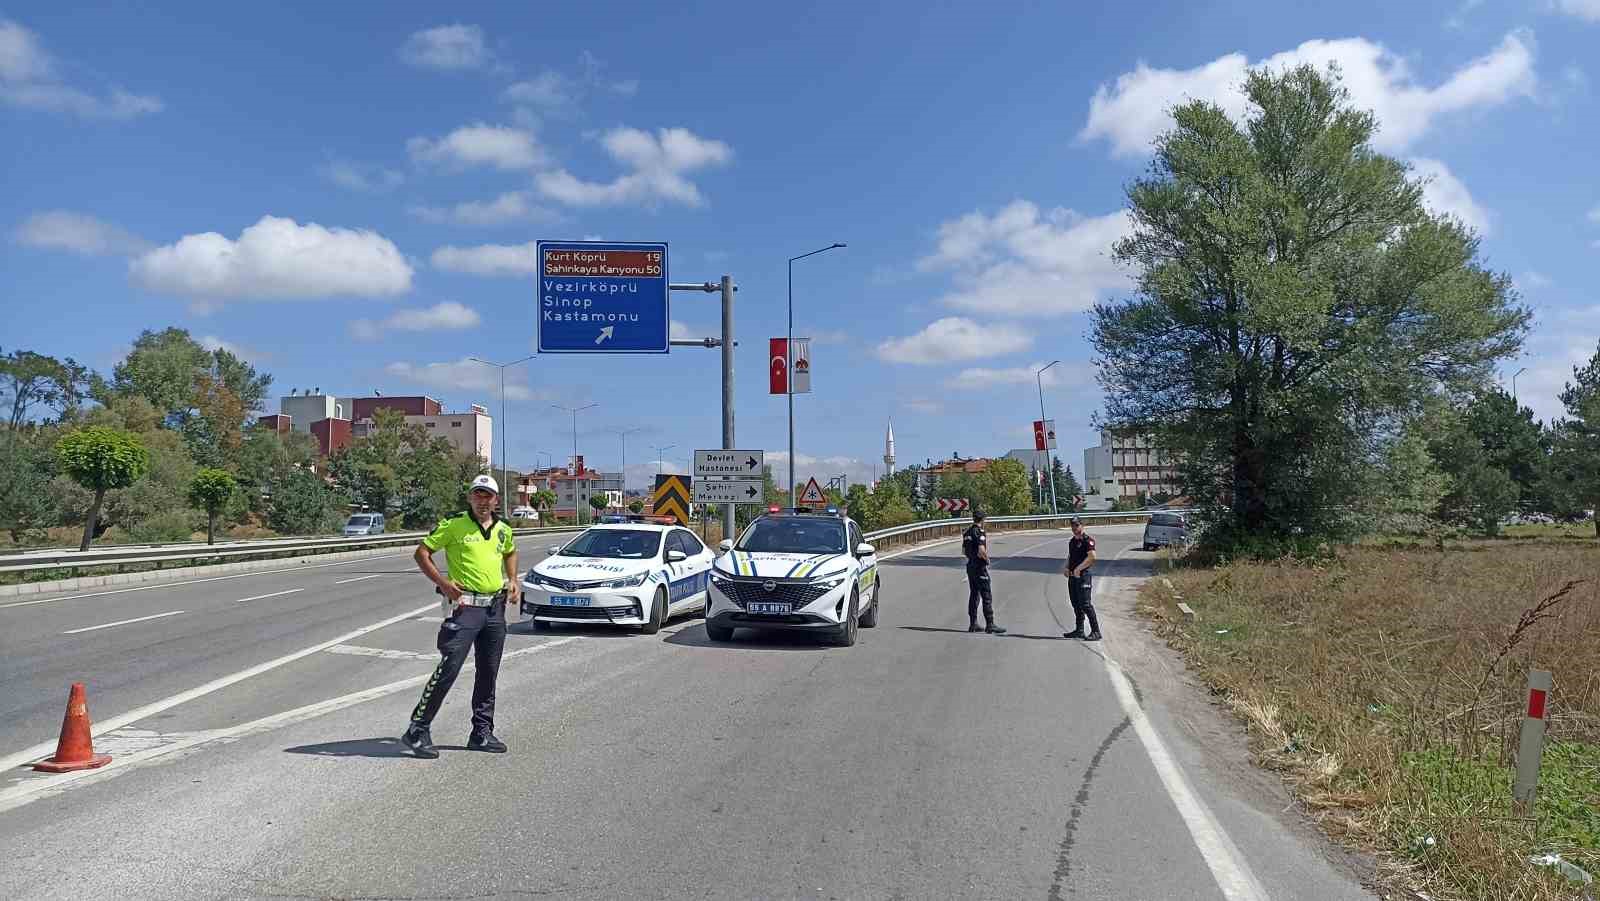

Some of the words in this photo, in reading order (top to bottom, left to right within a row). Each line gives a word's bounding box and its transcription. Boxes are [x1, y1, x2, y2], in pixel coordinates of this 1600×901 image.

[545, 252, 570, 261] Kurt
[646, 252, 660, 262] 19
[599, 264, 644, 276] Kanyonu
[646, 265, 661, 274] 50
[543, 280, 638, 296] Vezirköprü
[543, 295, 592, 309] Sinop
[543, 310, 639, 322] Kastamonu
[706, 454, 735, 462] Devlet
[698, 464, 743, 472] Hastanesi
[698, 493, 740, 501] Merkezi
